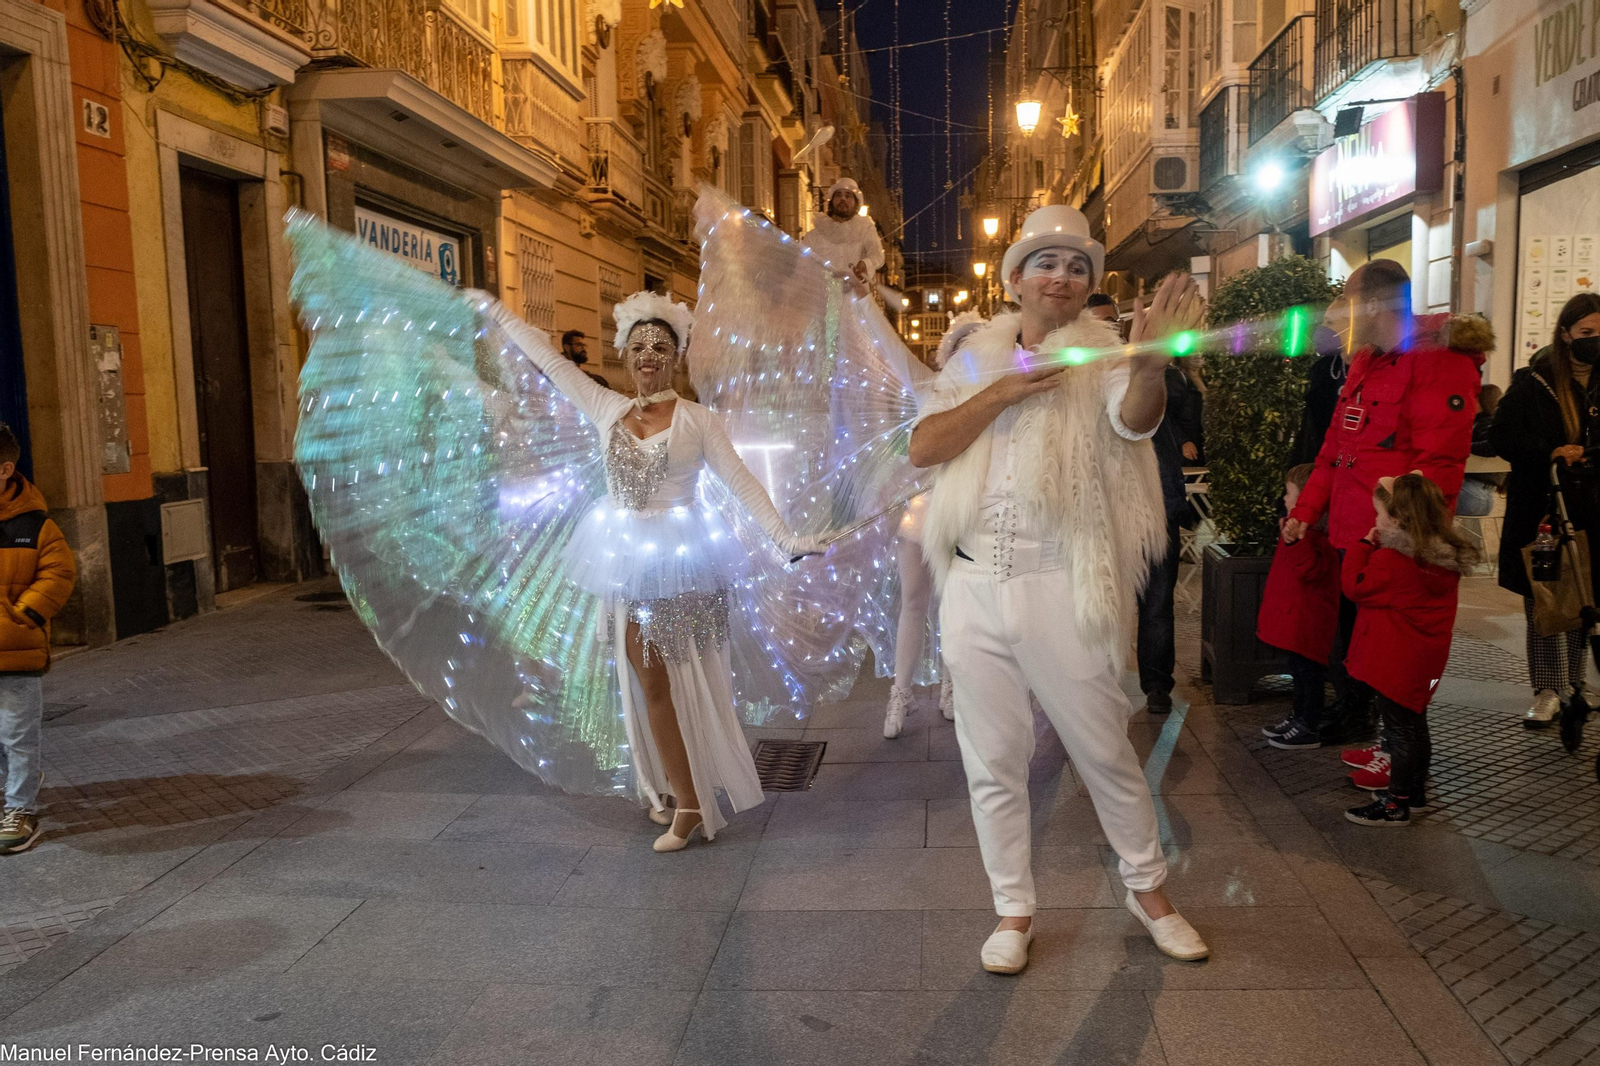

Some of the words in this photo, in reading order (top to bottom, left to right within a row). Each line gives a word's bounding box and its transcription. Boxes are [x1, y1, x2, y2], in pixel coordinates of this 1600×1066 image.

[1535, 0, 1586, 88] VERDE
[85, 102, 108, 134] 12
[358, 216, 433, 263] VANDERÍA
